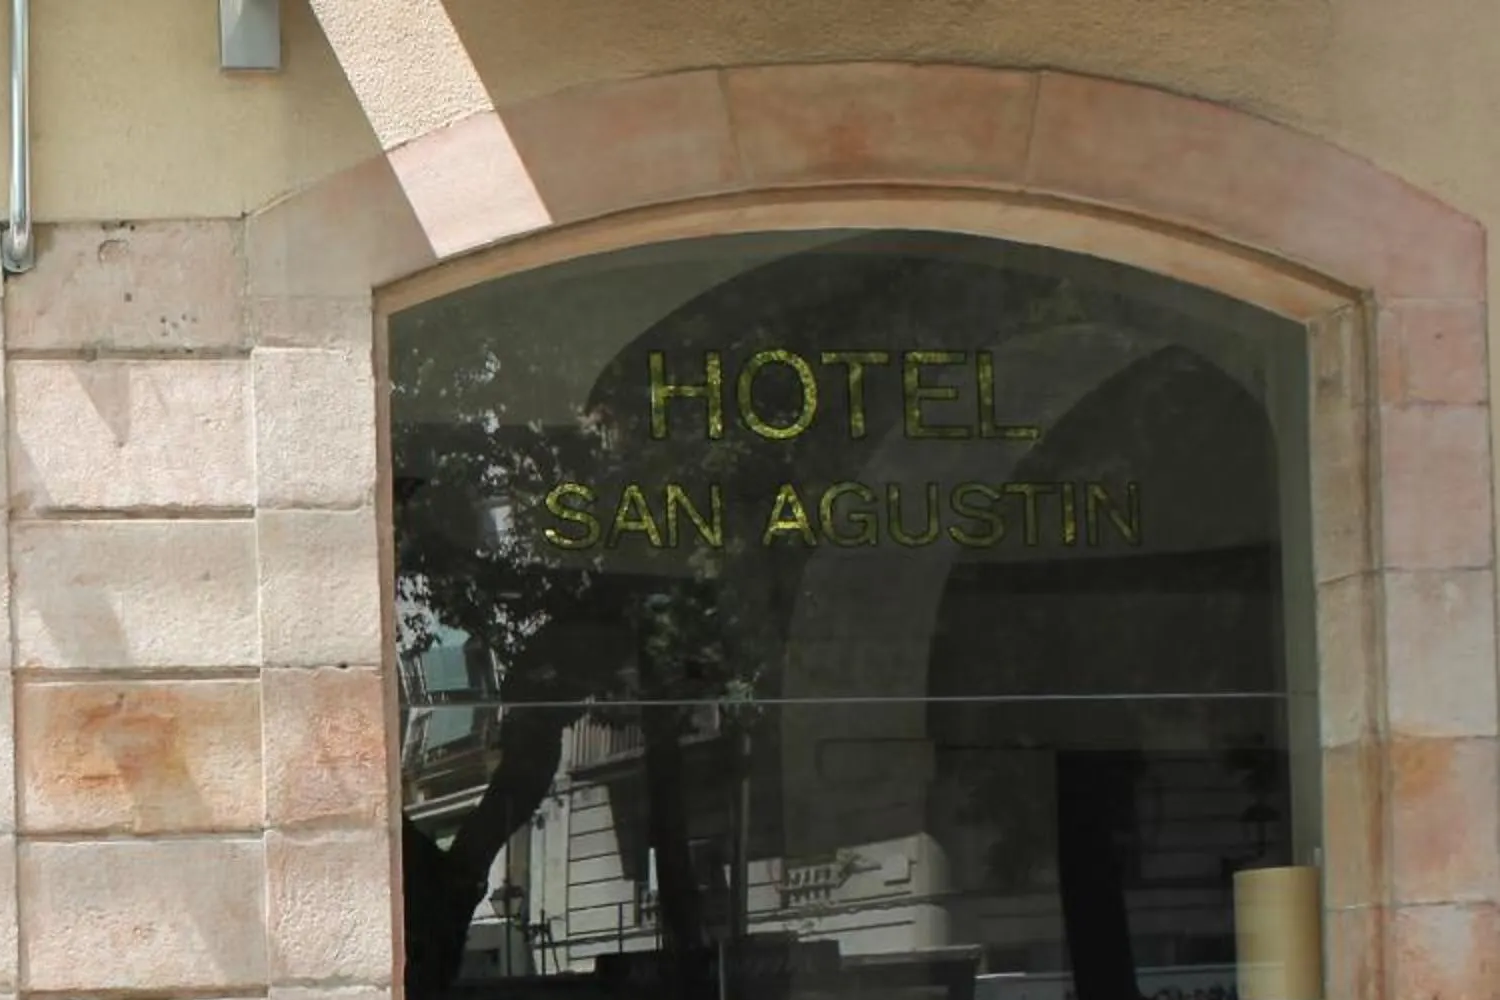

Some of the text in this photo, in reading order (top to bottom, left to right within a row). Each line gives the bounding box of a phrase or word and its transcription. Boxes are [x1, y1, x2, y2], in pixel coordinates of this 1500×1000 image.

[646, 349, 1041, 441] HOTEL
[543, 481, 1142, 549] SAN AGUSTIN
